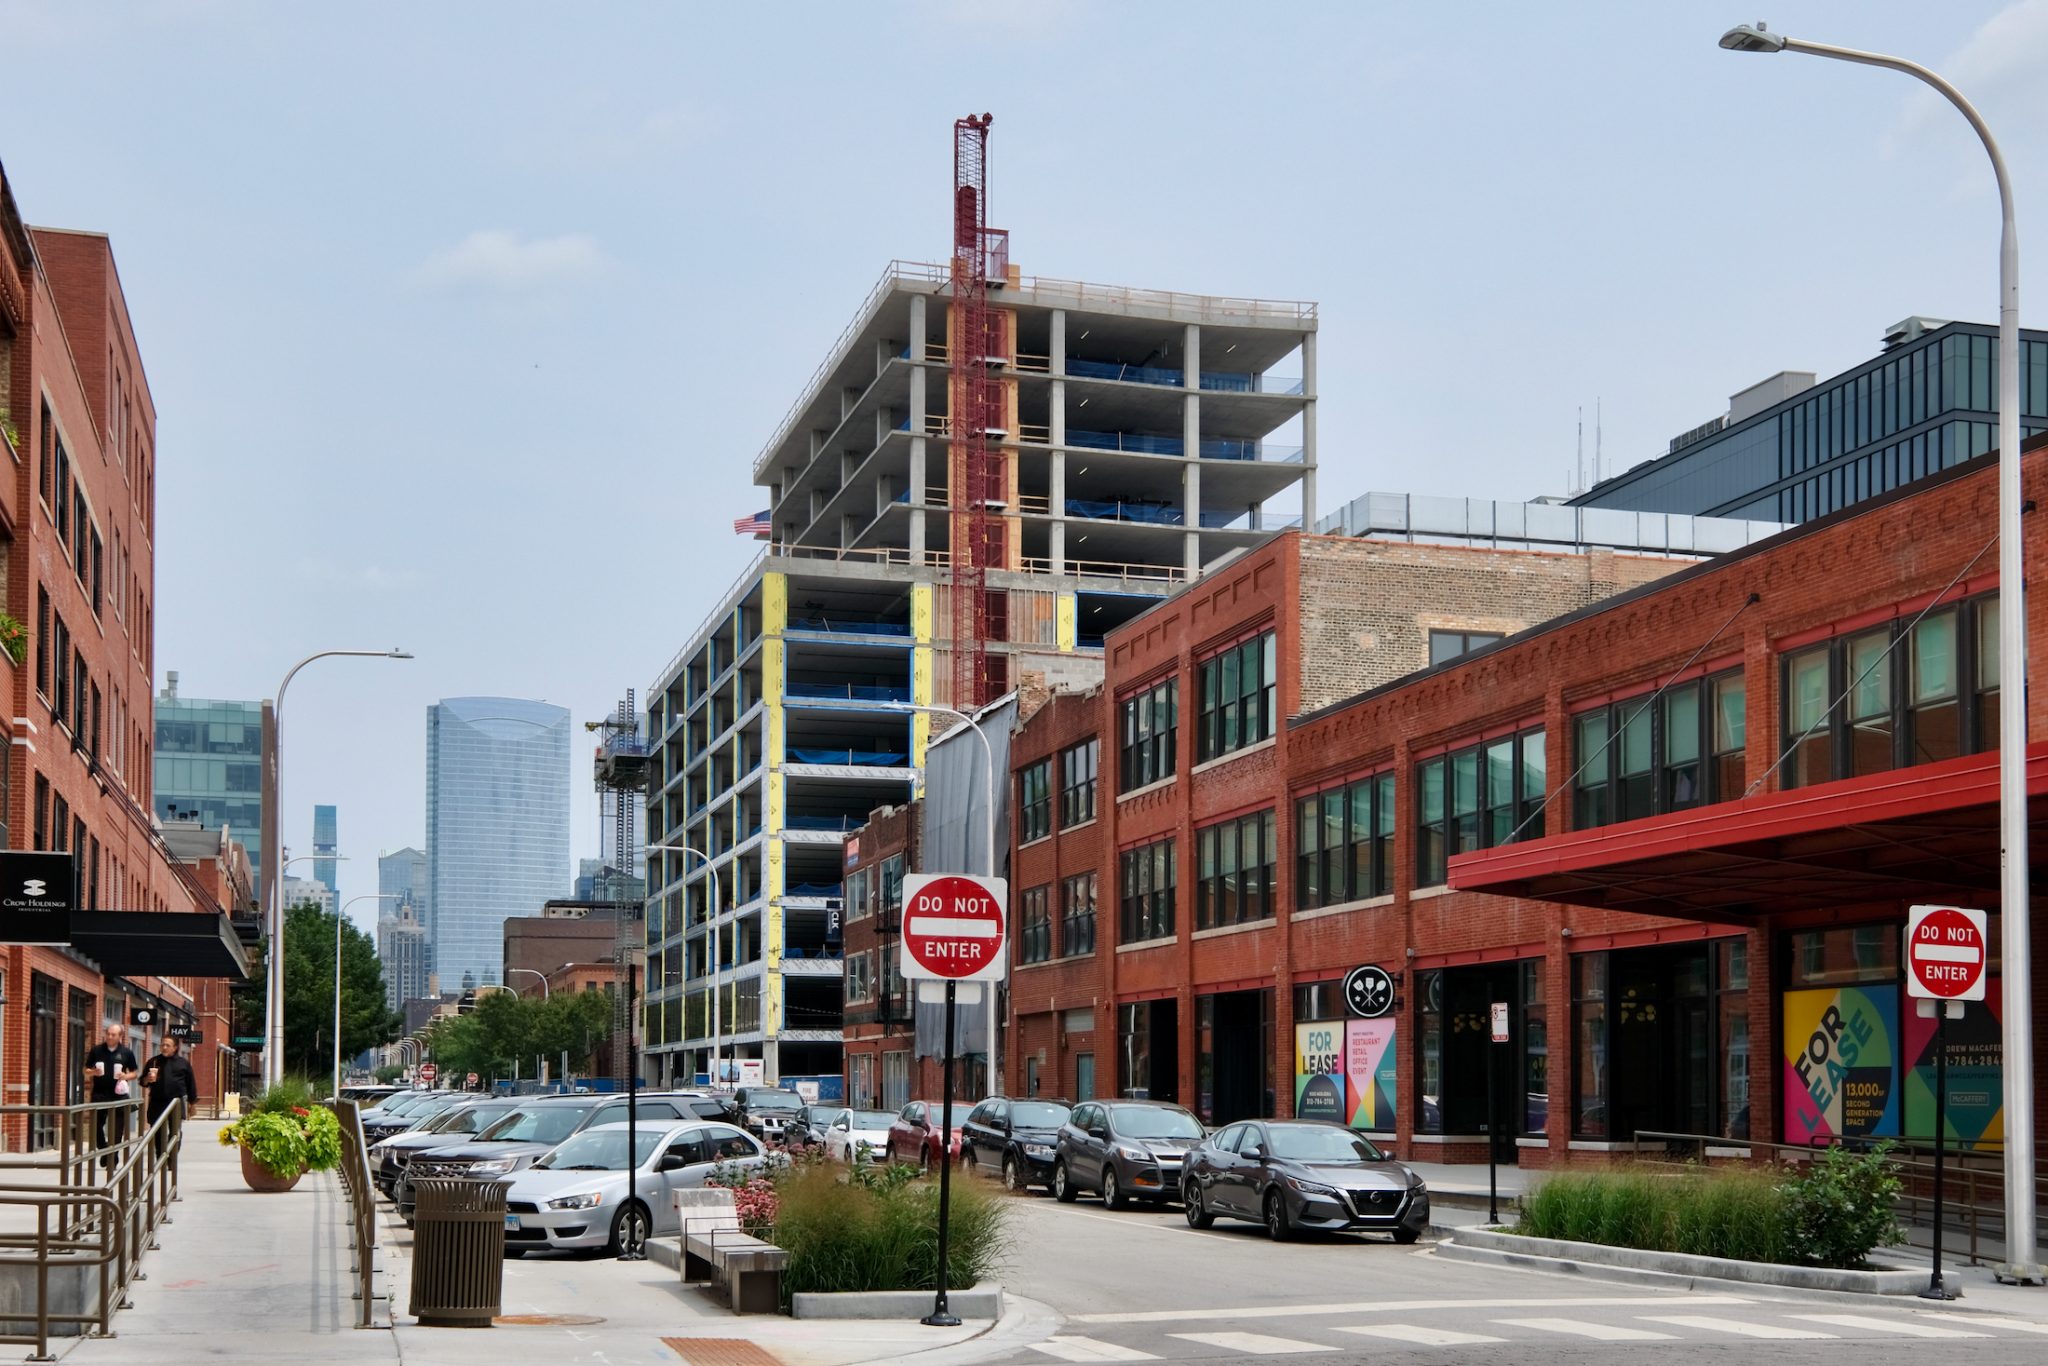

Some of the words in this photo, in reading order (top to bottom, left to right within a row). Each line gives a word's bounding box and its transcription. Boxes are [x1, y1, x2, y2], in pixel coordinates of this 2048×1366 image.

[3, 898, 27, 906] CROW
[28, 899, 66, 907] HOLDINGS
[919, 896, 943, 912] DO
[954, 897, 990, 914] NOT
[1921, 925, 1939, 940] DO
[1947, 927, 1974, 942] NOT
[925, 941, 981, 959] ENTER
[1926, 965, 1968, 981] ENTER
[171, 1028, 189, 1036] HAY
[1309, 1031, 1332, 1052] FOR
[1352, 1038, 1381, 1046] RESTAURANT
[1794, 1005, 1847, 1089] FOR
[1352, 1048, 1367, 1056] RETAIL
[1302, 1054, 1339, 1075] LEASE
[1352, 1057, 1367, 1065] OFFICE
[1352, 1067, 1367, 1075] EVENT
[1798, 1008, 1873, 1132] LEASE
[1846, 1083, 1879, 1097] 13,000
